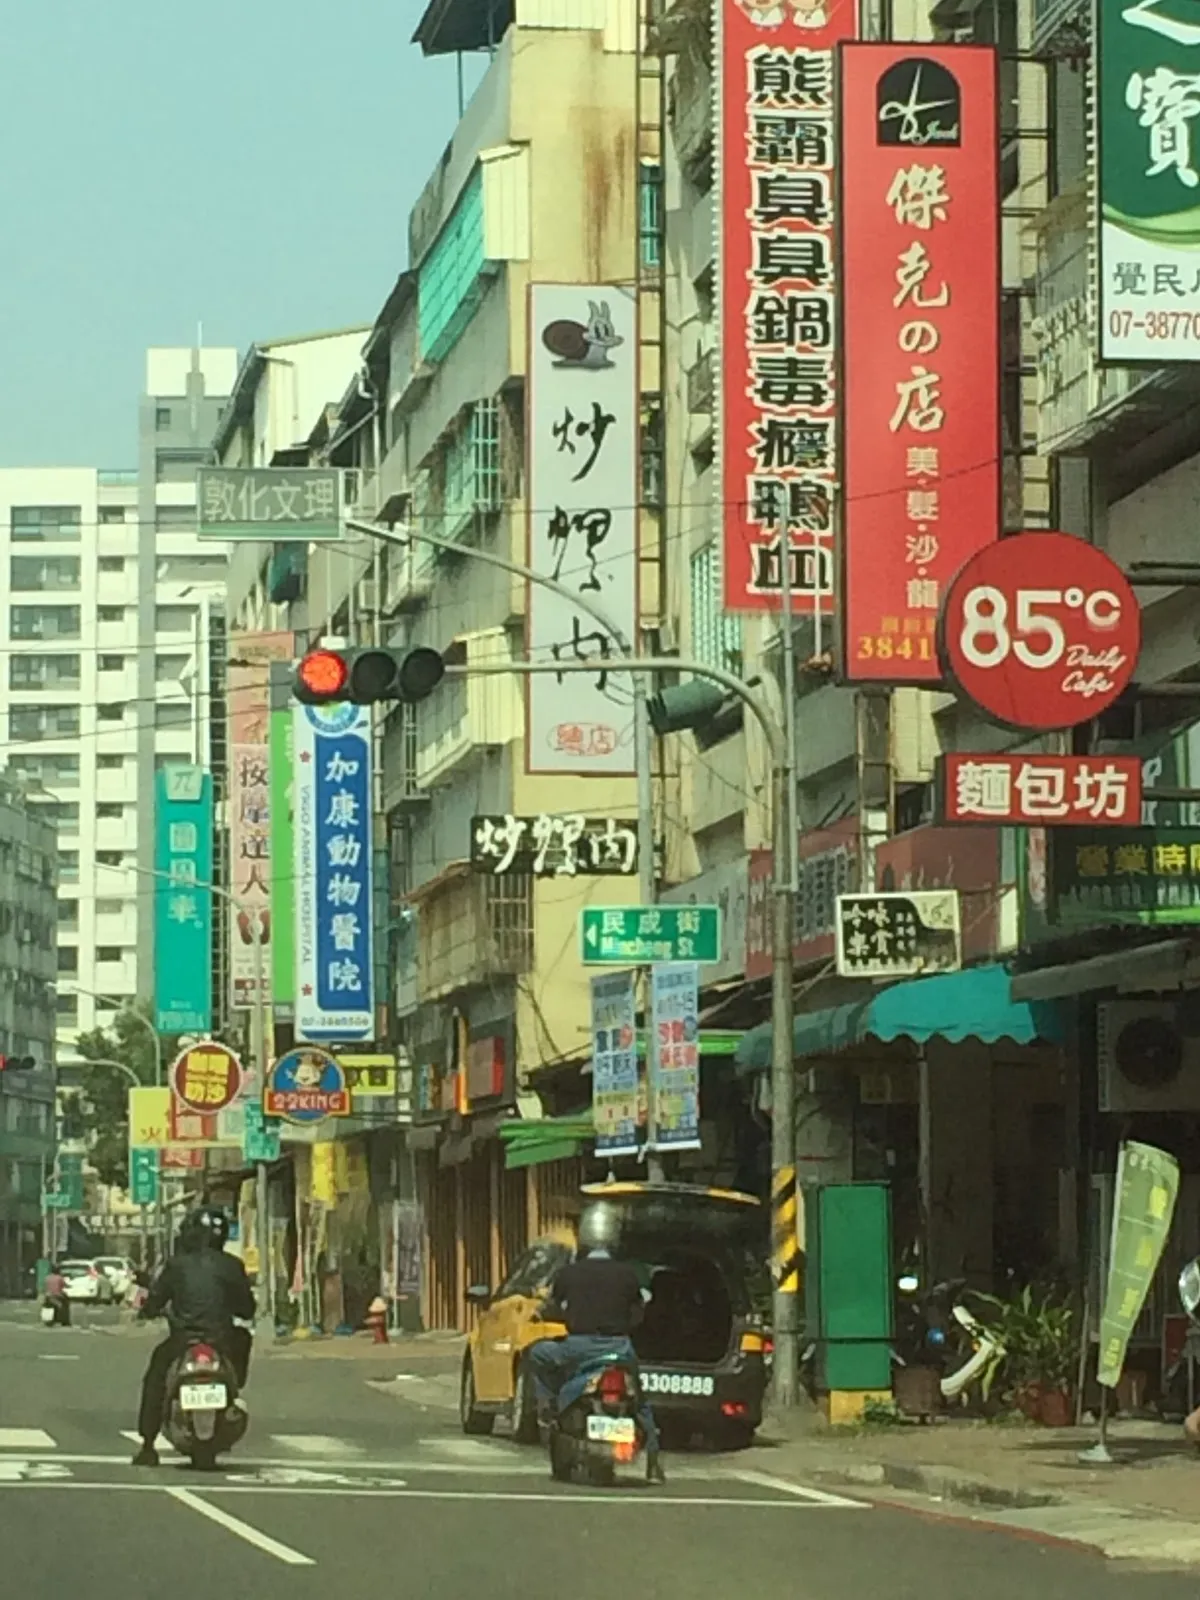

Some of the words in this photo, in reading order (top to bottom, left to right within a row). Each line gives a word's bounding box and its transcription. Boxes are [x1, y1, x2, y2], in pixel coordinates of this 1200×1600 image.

[887, 164, 950, 433] 傑克の店
[204, 476, 335, 522] 敦化文理
[1066, 644, 1127, 673] Daily
[956, 761, 1129, 817] 麵包坊
[324, 751, 362, 992] 加康動物醫院
[602, 911, 701, 935] 民成街
